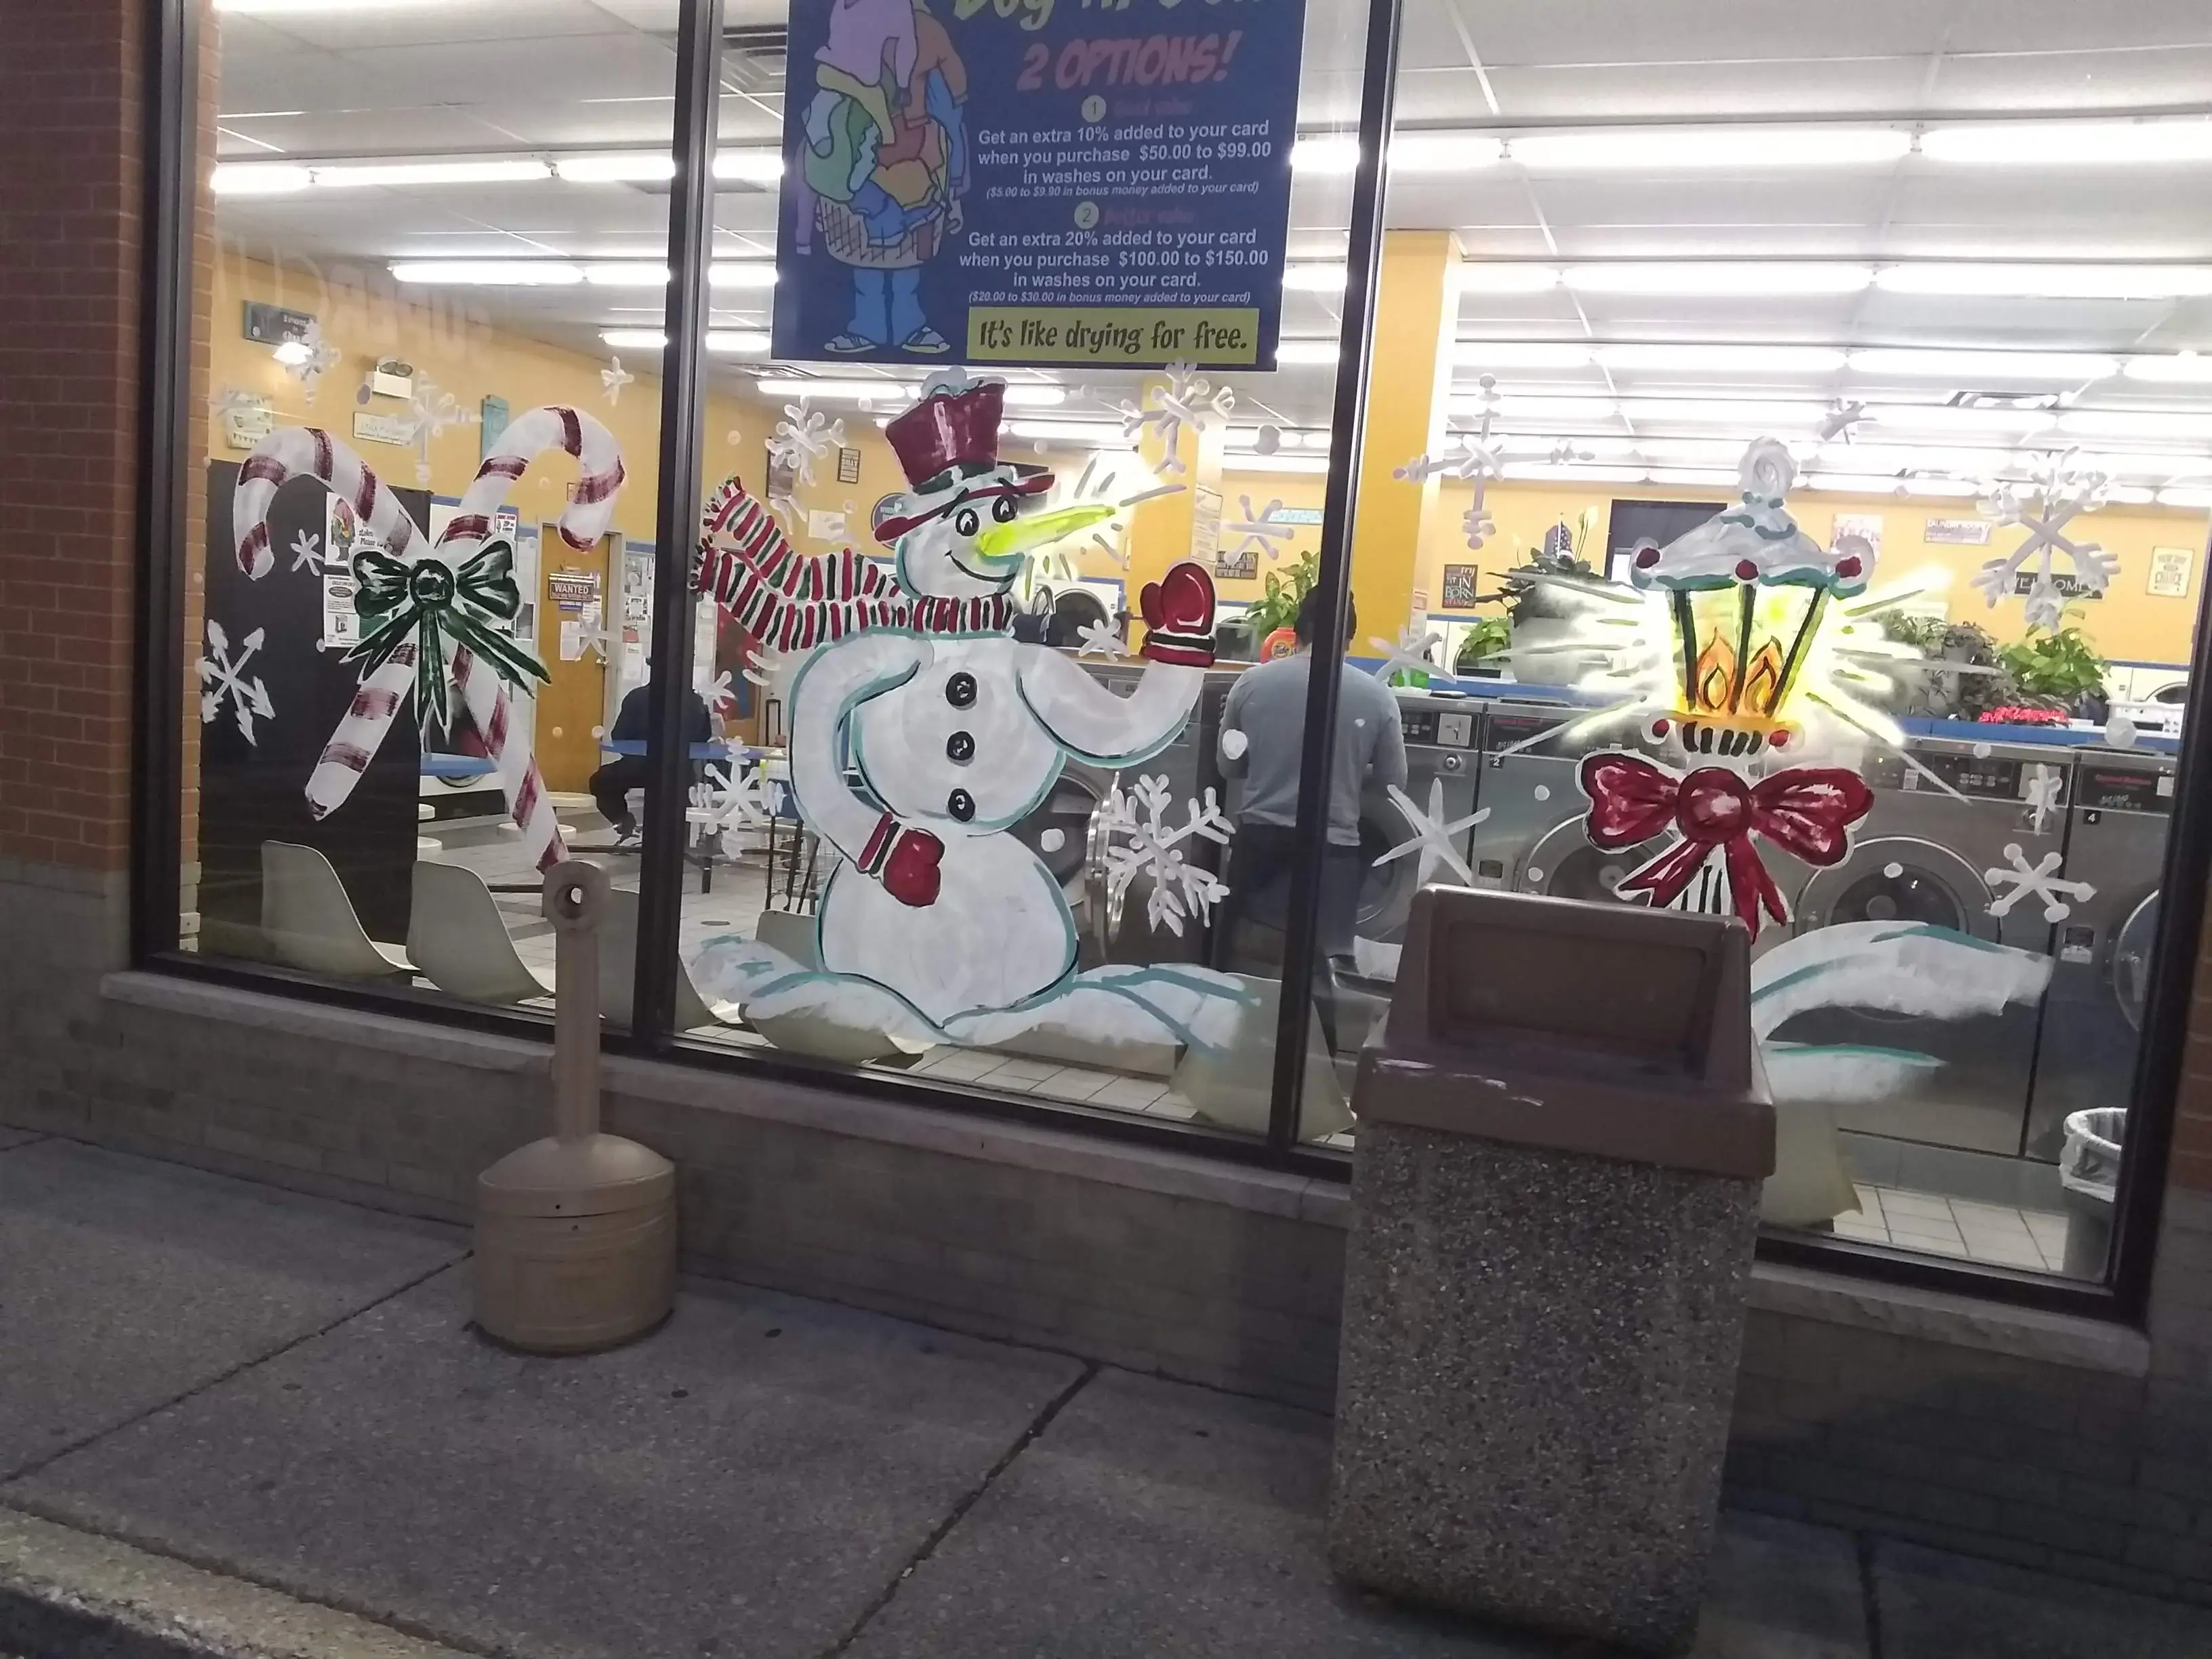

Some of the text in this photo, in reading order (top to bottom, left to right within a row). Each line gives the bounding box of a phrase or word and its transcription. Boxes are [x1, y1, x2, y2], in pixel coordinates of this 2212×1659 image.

[1017, 30, 1243, 91] 2 OPTIONS!
[979, 119, 1269, 145] Get an extra 10% added to your card
[978, 141, 1271, 167] when you purchase $50.00 to $99.00
[1023, 164, 1213, 186] in washes on your card.
[1020, 187, 1030, 197] to
[1063, 186, 1073, 197] in
[1076, 185, 1109, 197] bonus
[1111, 186, 1149, 197] money
[1151, 183, 1185, 194] added
[1187, 184, 1199, 194] to
[1200, 184, 1227, 196] your
[1229, 182, 1260, 194] card)
[968, 228, 1257, 249] Get an extra 20% added to your card
[960, 249, 1269, 270] when you purchase $100.00 to $150.00
[1013, 272, 1202, 291] in washes on your card.
[968, 291, 1251, 305] ($20.00 to $30.00 in bonus money added to your card)
[979, 319, 1248, 355] It's like drying for free.
[554, 583, 589, 594] WANTED
[1445, 585, 1473, 599] BORN
[2087, 813, 2096, 823] 4
